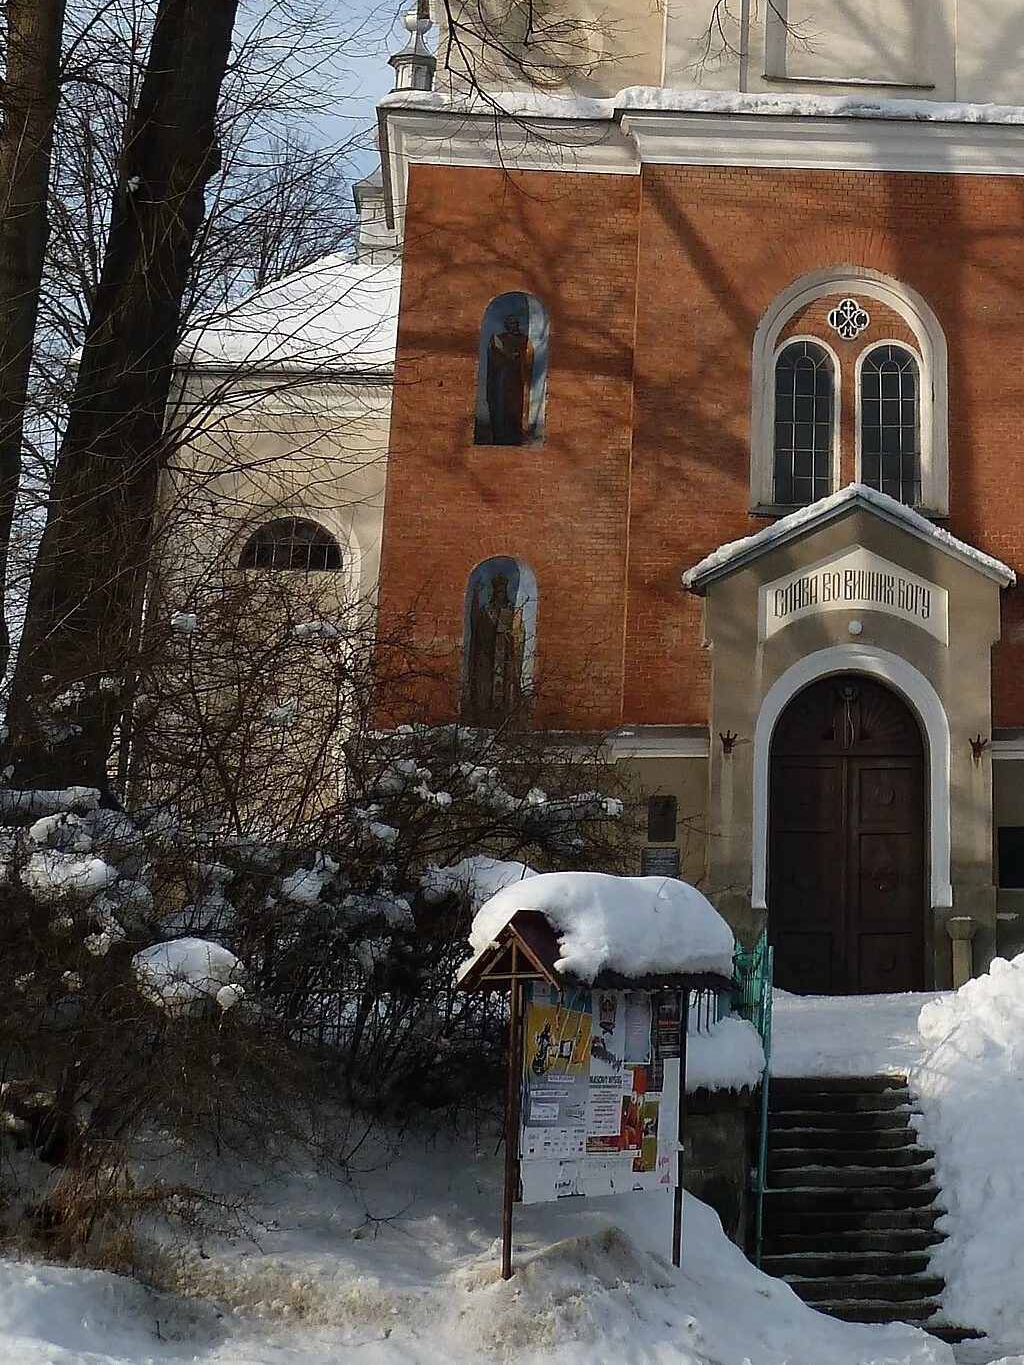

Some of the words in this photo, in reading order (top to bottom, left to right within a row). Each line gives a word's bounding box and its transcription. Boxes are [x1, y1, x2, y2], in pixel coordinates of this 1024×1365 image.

[774, 574, 819, 619] СЛАВА
[822, 571, 841, 602] ВО
[844, 569, 895, 606] ВИШНИХ
[898, 578, 931, 620] БОГУ
